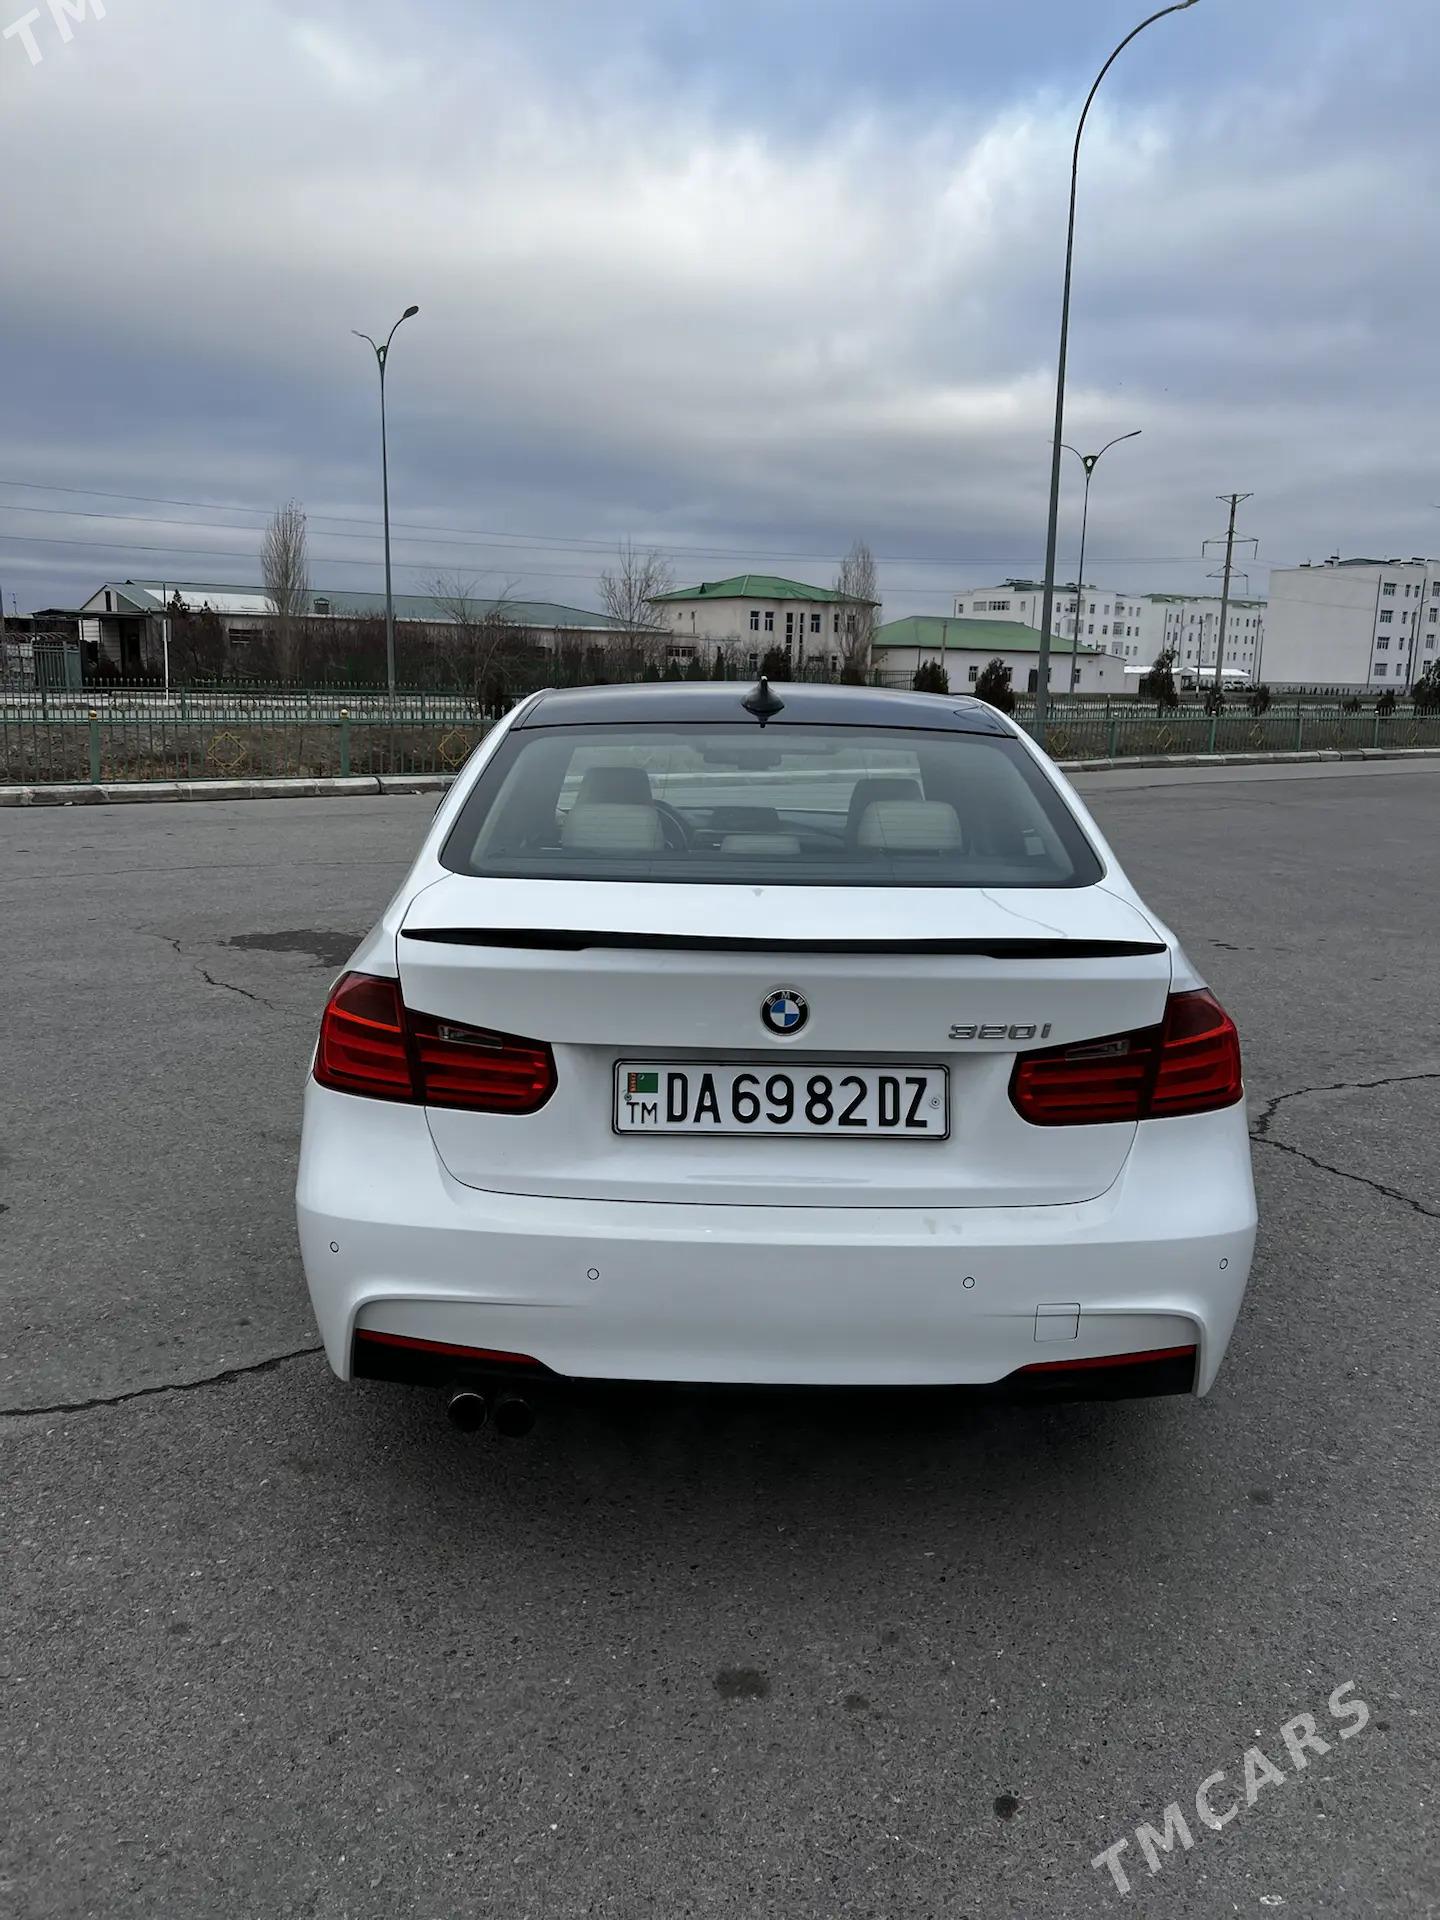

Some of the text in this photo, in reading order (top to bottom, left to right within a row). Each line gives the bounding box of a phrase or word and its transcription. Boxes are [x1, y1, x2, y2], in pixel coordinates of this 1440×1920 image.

[766, 990, 805, 1007] BMW
[948, 1023, 1052, 1040] 320i
[626, 1102, 658, 1124] TM
